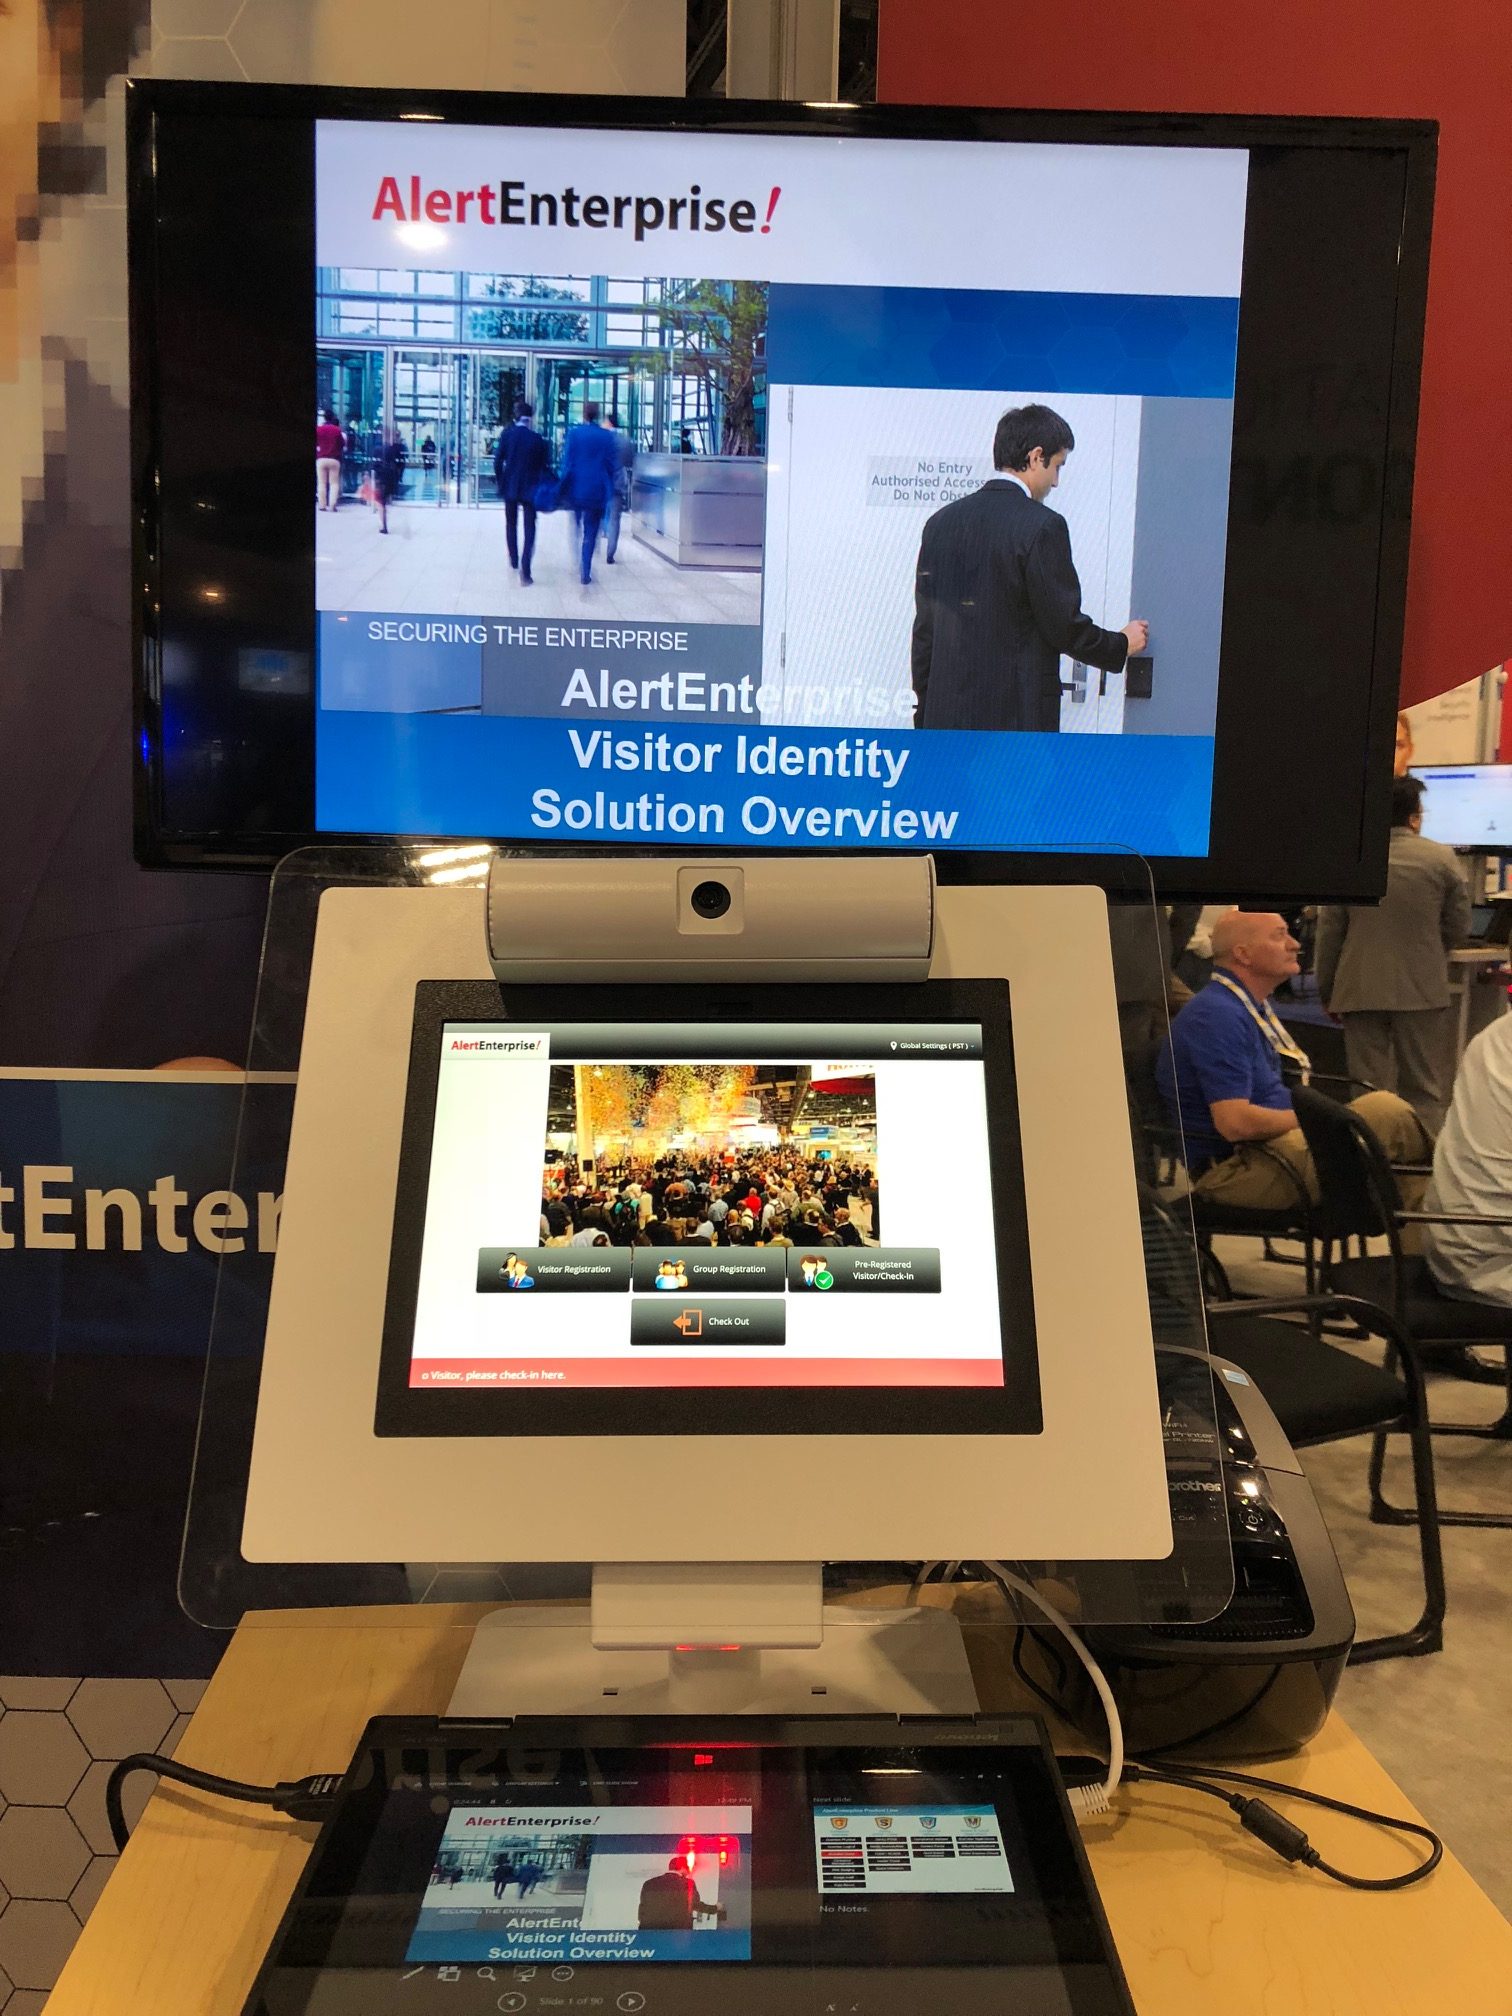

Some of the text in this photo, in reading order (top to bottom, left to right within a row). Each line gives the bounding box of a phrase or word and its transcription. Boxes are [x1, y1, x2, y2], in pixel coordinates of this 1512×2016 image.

[372, 176, 781, 242] AlertEnterprise!
[917, 462, 973, 476] No Entry
[872, 474, 940, 487] Authorised
[893, 489, 910, 501] Do
[914, 490, 936, 501] Not
[367, 621, 689, 652] SECURING THE ENTERPRISE
[561, 668, 919, 724] AlertEnterprise
[568, 728, 910, 789] Visitor Identity
[530, 788, 959, 841] Solution Overview
[451, 1040, 541, 1052] AlertEnterprise!
[900, 1041, 921, 1050] Global
[922, 1041, 948, 1051] Settings
[537, 1265, 611, 1275] Visitor Registration
[693, 1264, 766, 1276] Group Registration
[854, 1260, 912, 1270] Pre-Registered
[708, 1317, 750, 1326] Check Out
[431, 1371, 464, 1381] Visitor,
[466, 1371, 497, 1382] please
[499, 1370, 539, 1380] check-in
[541, 1370, 566, 1380] here.
[465, 1816, 601, 1829] AlertEnterprise!
[503, 1907, 556, 1915] ENTERPRISE
[819, 1905, 835, 1913] No
[507, 1932, 636, 1945] Visitor Identity
[488, 1947, 655, 1959] Solution Overview
[540, 1996, 564, 2006] Slide
[576, 1996, 589, 2006] of
